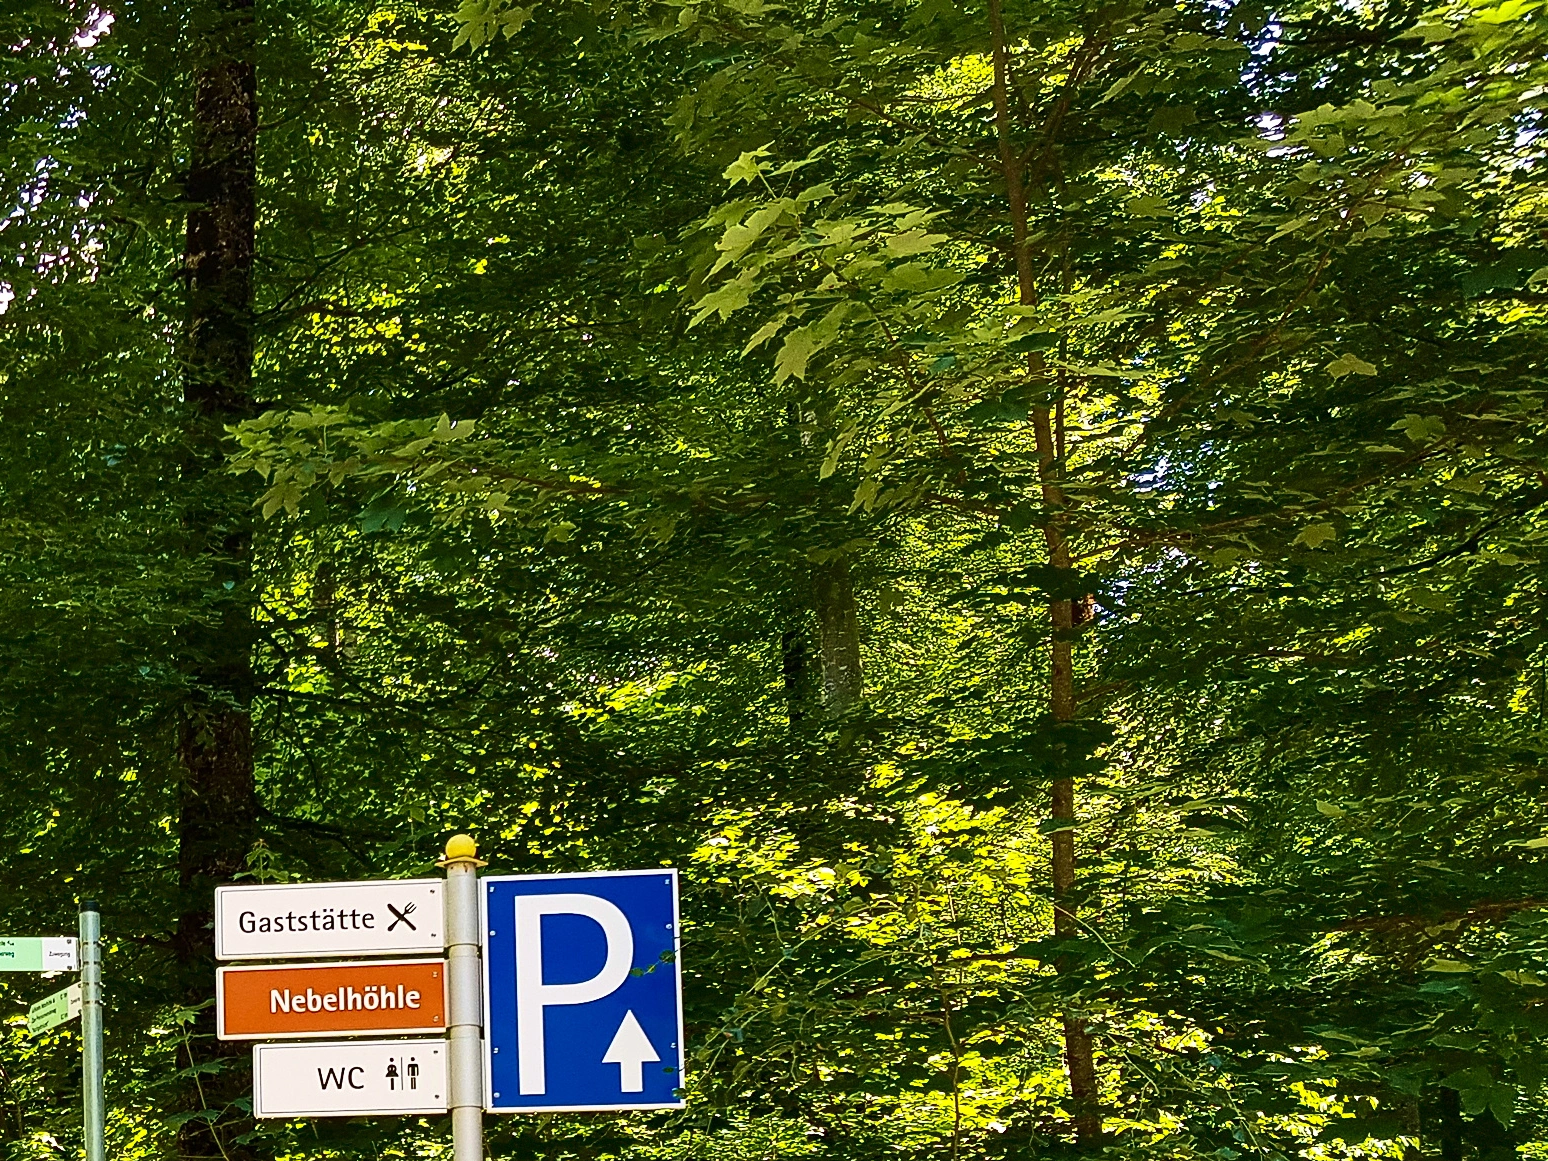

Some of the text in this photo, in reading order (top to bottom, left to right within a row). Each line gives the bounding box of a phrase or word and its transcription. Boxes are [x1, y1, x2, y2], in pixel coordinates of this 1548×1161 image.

[239, 907, 376, 934] Gaststätte
[270, 984, 421, 1014] Nebelhöhle
[514, 893, 634, 1096] P
[317, 1066, 365, 1090] WC
